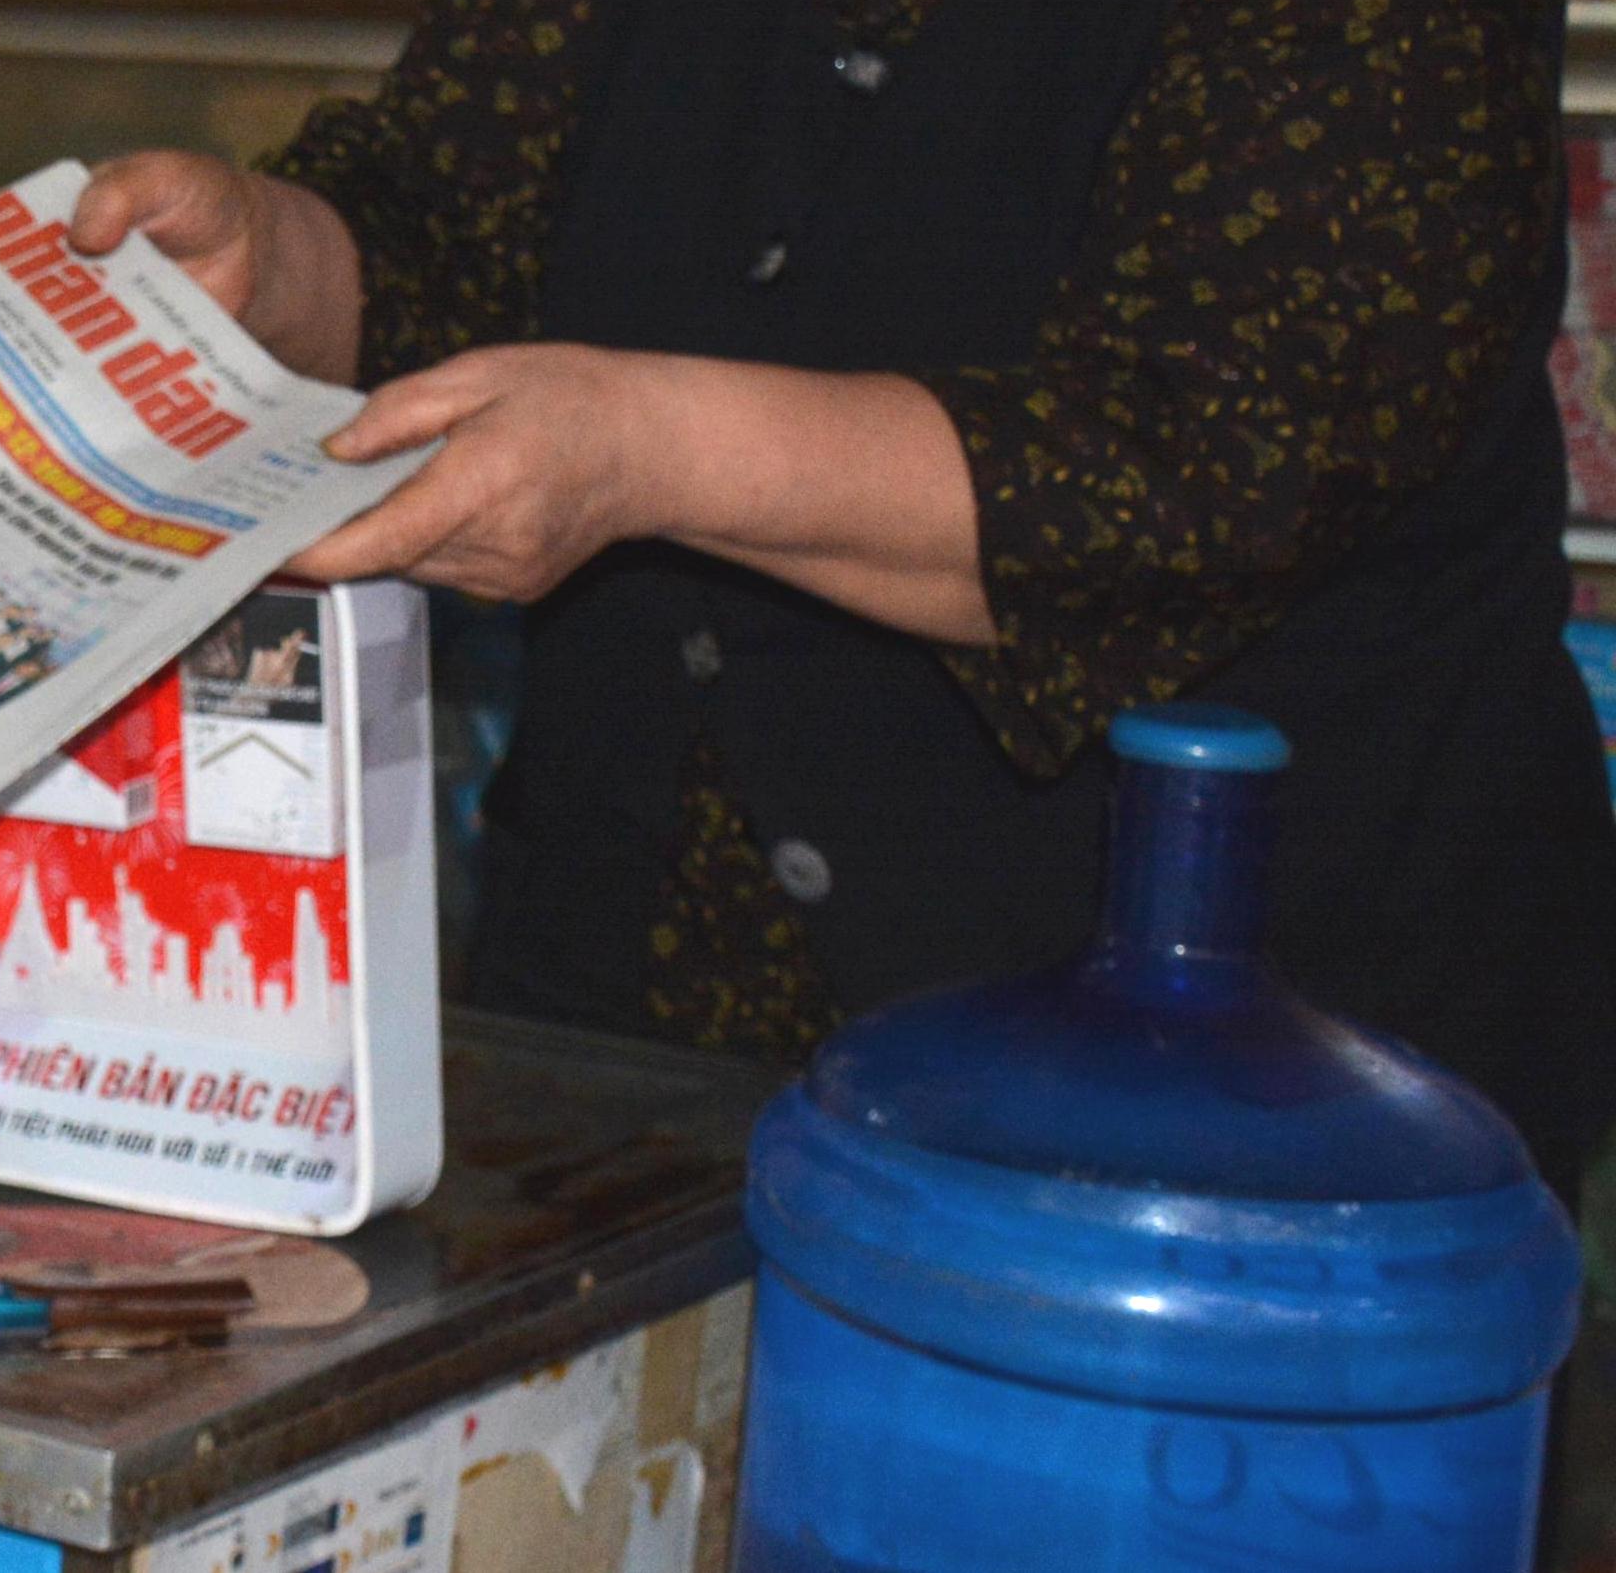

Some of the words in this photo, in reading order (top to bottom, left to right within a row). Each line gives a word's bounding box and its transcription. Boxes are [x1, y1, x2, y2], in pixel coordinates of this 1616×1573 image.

[99, 340, 252, 462] dân
[98, 1050, 186, 1112] BẢN
[185, 1069, 271, 1126] ĐẶC
